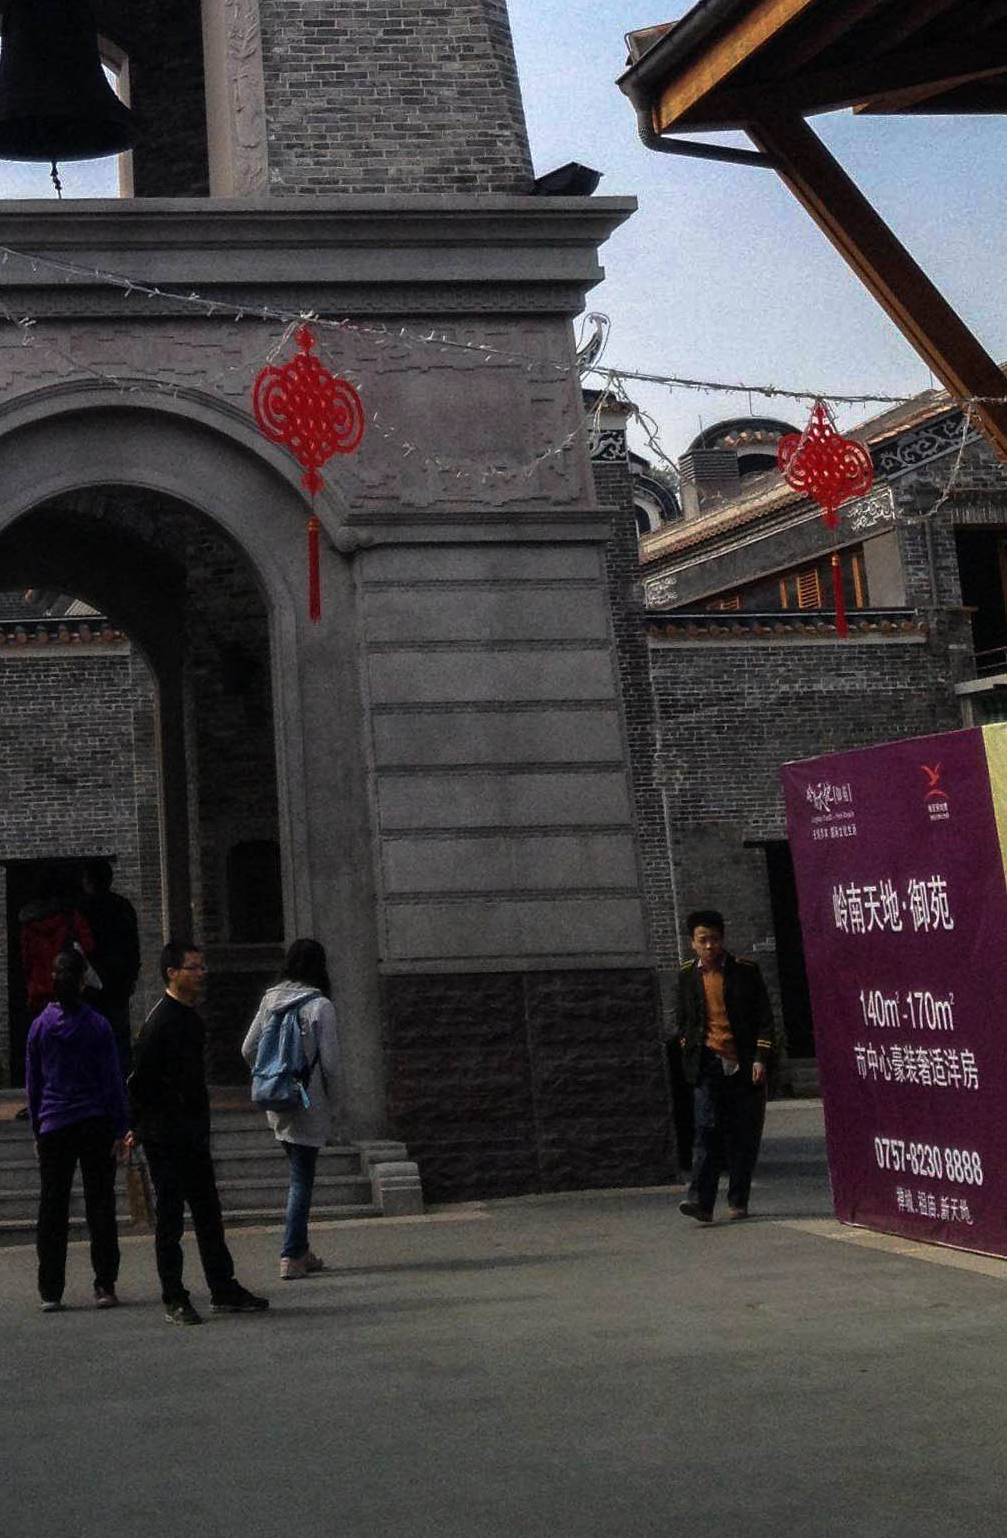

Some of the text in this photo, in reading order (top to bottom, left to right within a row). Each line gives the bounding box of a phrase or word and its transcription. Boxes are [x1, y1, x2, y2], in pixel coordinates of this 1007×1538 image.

[853, 1041, 980, 1090] 市中心豪装奢适洋房
[874, 1136, 984, 1186] 0757-8230 8888
